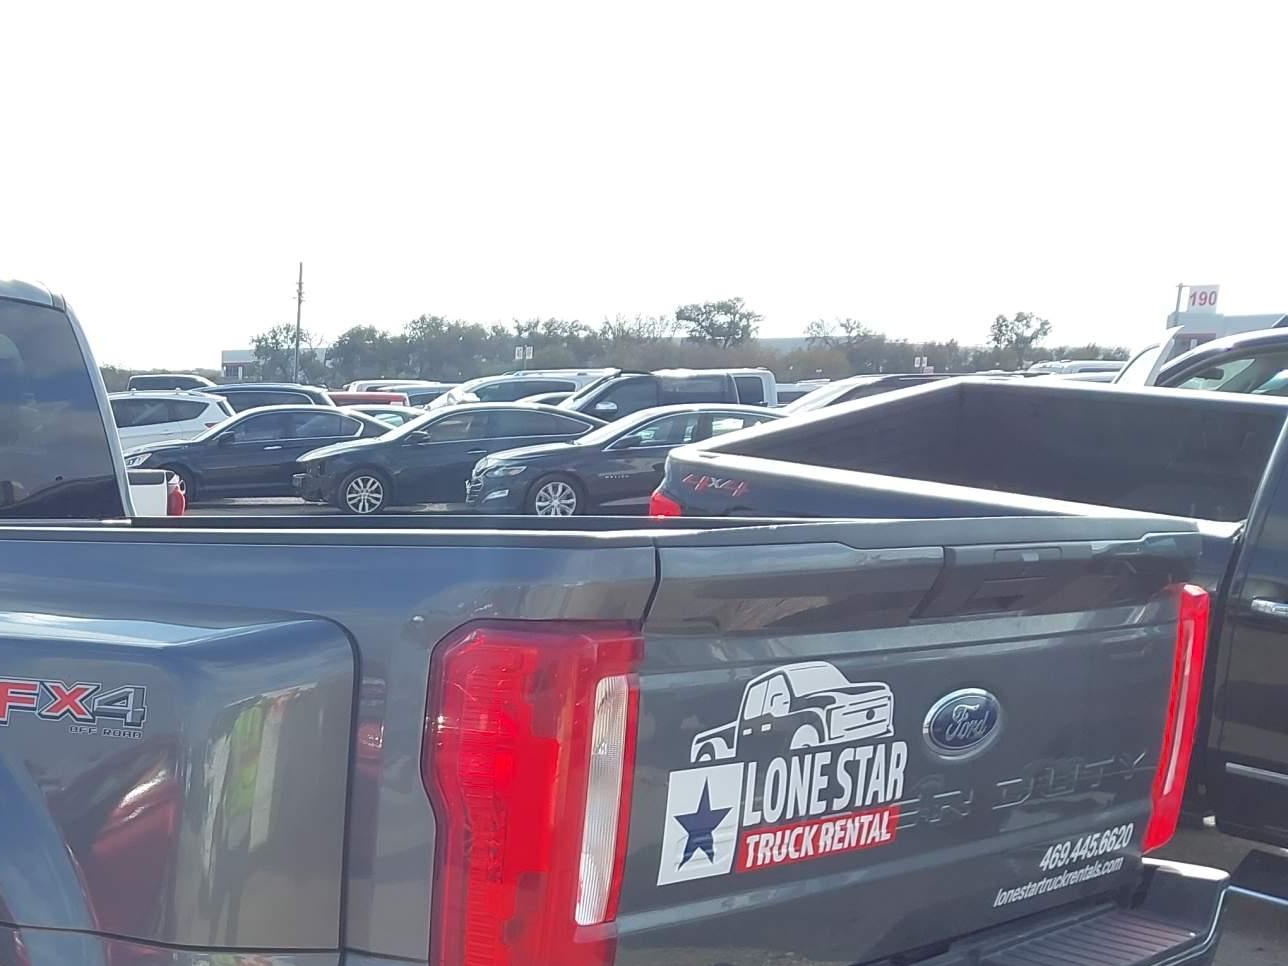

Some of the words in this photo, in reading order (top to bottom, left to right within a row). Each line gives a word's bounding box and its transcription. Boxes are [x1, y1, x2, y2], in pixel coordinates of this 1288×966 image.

[1190, 290, 1218, 306] 190
[69, 725, 97, 735] OFF
[103, 728, 143, 739] ROAD
[945, 704, 991, 742] Ford
[743, 752, 831, 827] LONE
[831, 740, 908, 804] STAR
[745, 832, 816, 869] TRUCK
[817, 815, 891, 856] RENTAL
[1039, 822, 1134, 872] 469.445.6620
[992, 856, 1124, 908] lonestartruckrentals.com
